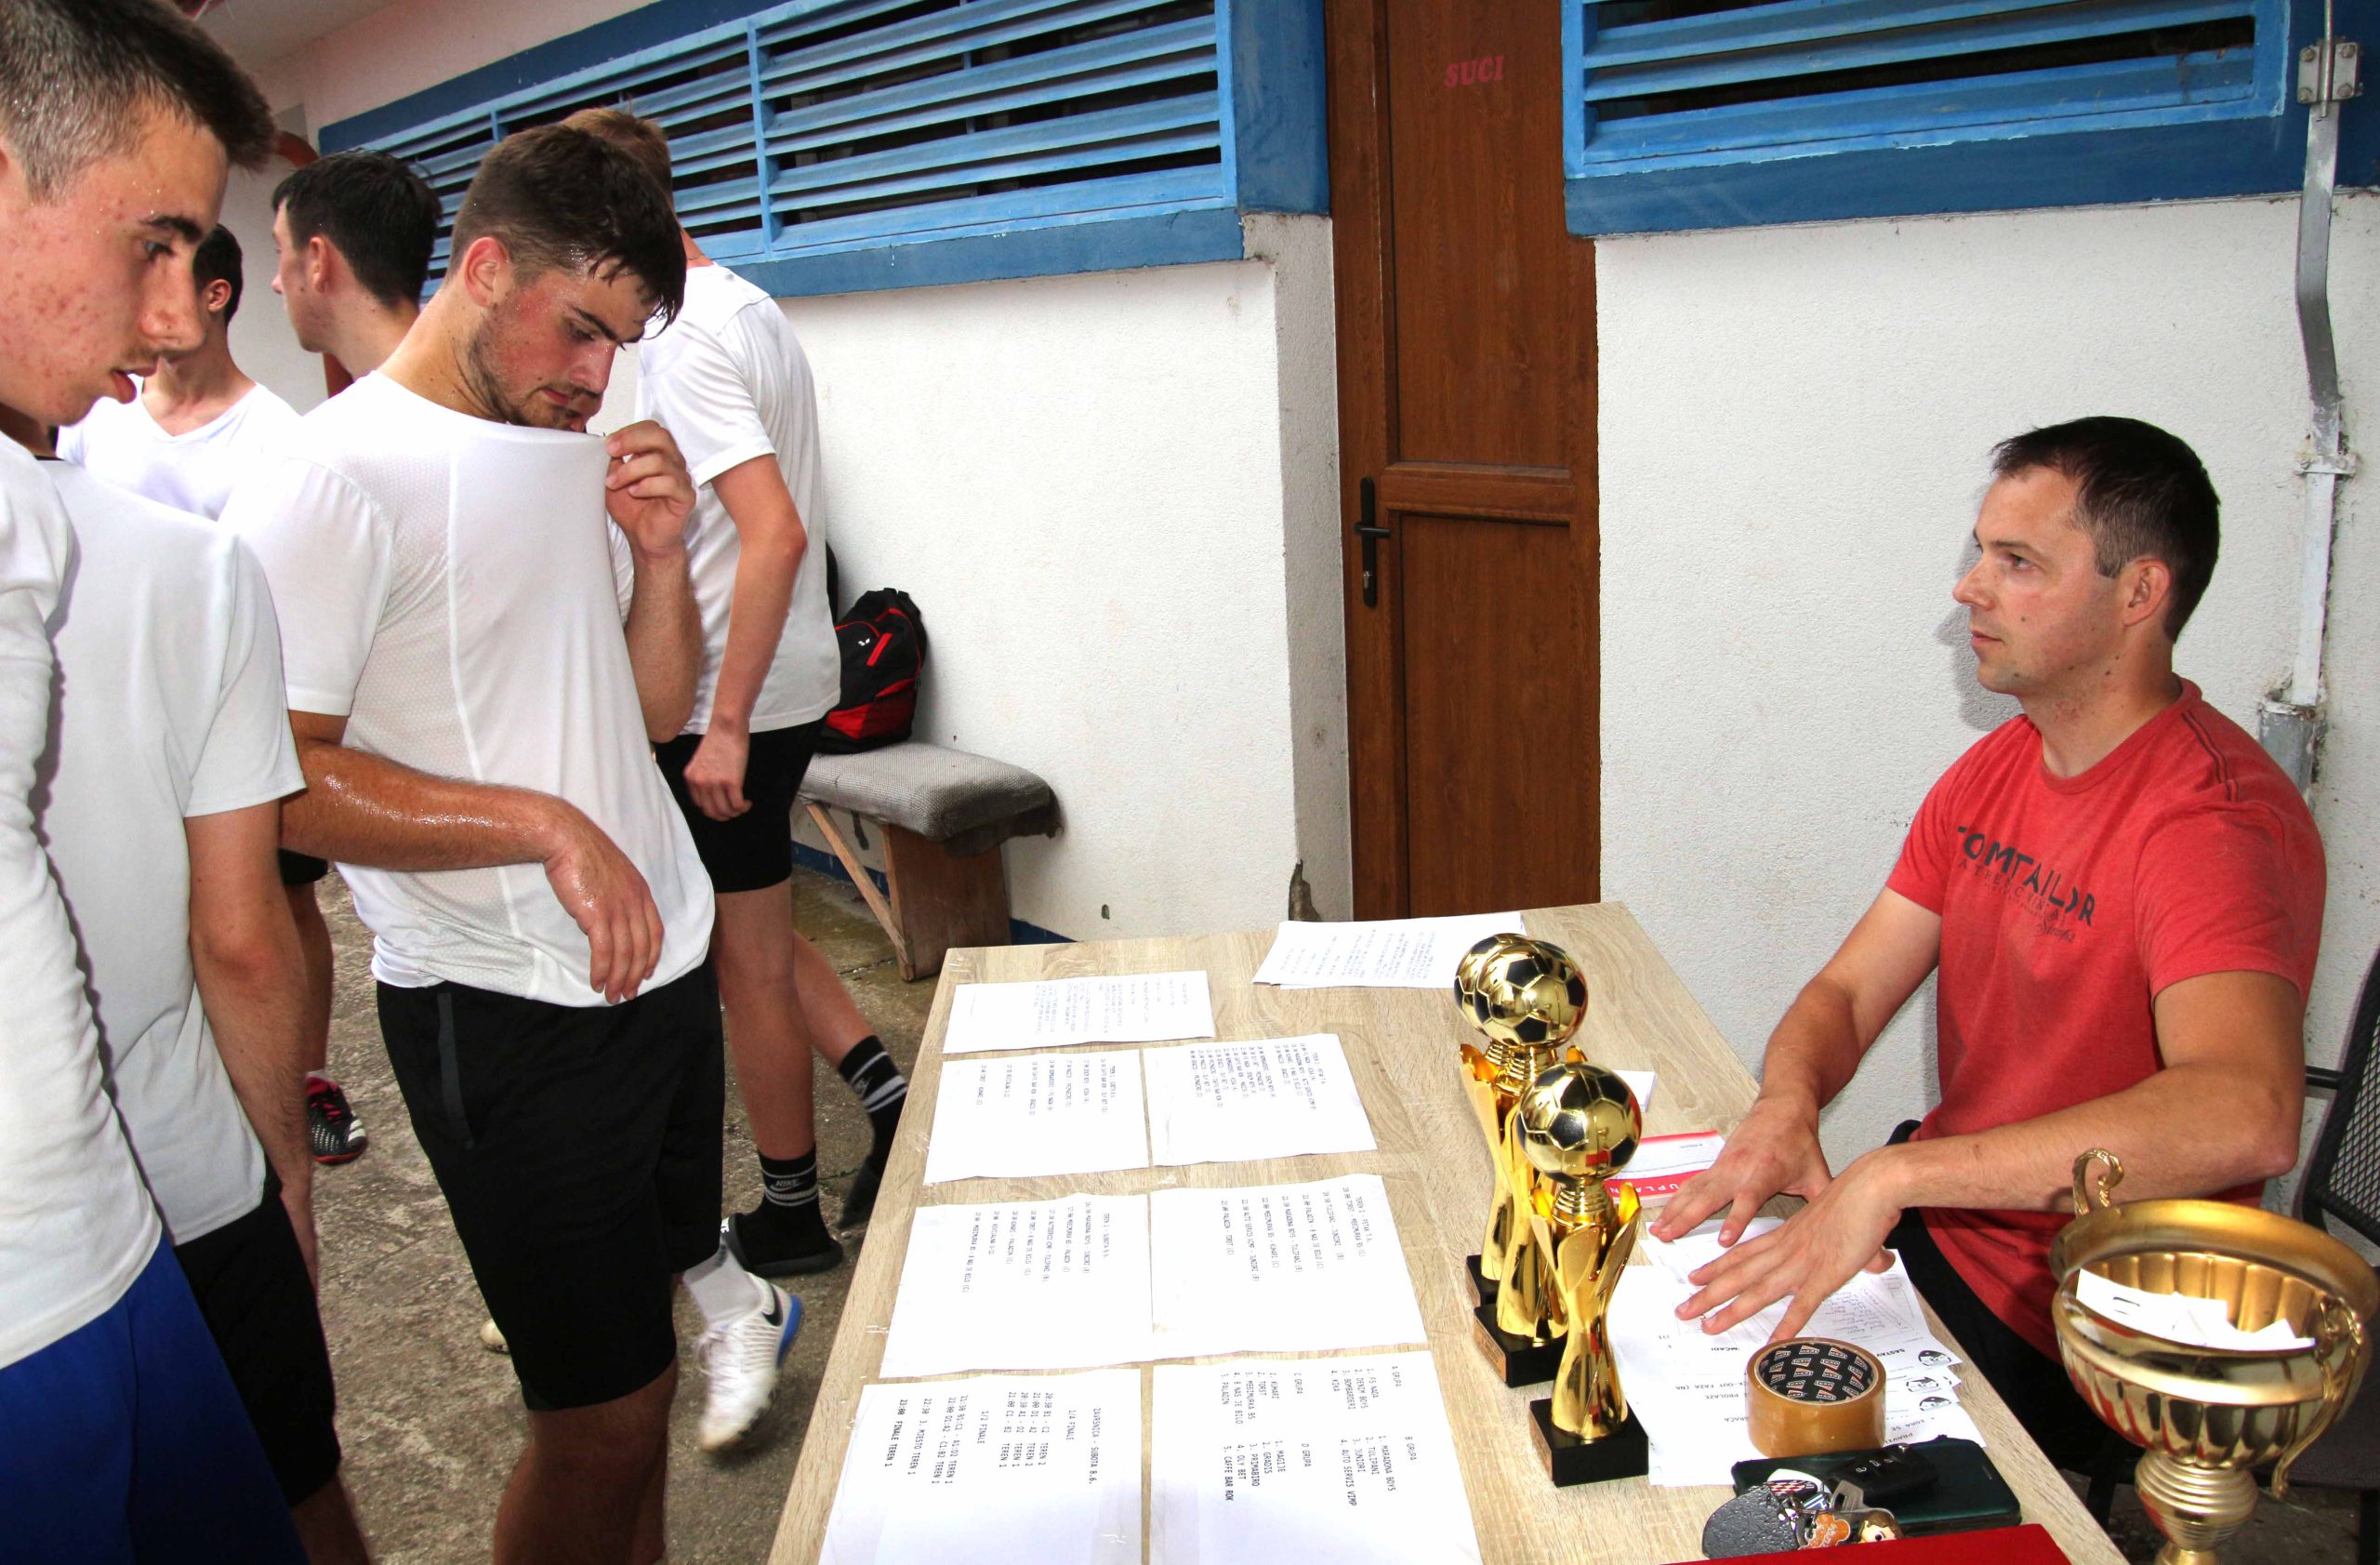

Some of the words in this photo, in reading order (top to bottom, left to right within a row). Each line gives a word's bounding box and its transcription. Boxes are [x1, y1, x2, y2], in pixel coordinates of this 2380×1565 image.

[1258, 1381, 1267, 1396] TORST
[1294, 1379, 1303, 1394] GRUPA
[1355, 1378, 1366, 1394] DENIM
[1392, 1372, 1402, 1387] GRUPA
[1222, 1382, 1230, 1405] PALADIN
[1234, 1387, 1242, 1397] NAS
[1343, 1378, 1355, 1410] BOMBARDERI
[897, 1399, 908, 1415] 23:00
[1359, 1396, 1368, 1409] BOYS
[1235, 1410, 1243, 1424] BILO
[891, 1421, 903, 1440] FINALE
[914, 1429, 925, 1450] MJESTO
[977, 1424, 987, 1444] FINALE
[1066, 1422, 1076, 1440] FINALE
[886, 1443, 898, 1461] TEREN
[1000, 1443, 1010, 1461] TEREN
[1012, 1443, 1023, 1461] TEREN
[1025, 1442, 1036, 1460] TEREN
[1038, 1442, 1049, 1459] TEREN
[1090, 1447, 1099, 1467] SUBOTA
[1302, 1450, 1312, 1467] GRUPA
[1342, 1450, 1351, 1464] AUTO
[1382, 1445, 1393, 1474] MARADONA
[1407, 1443, 1417, 1461] GRUPA
[909, 1452, 920, 1469] TEREN
[946, 1460, 957, 1478] TEREN
[1223, 1456, 1233, 1473] CAFFE
[1236, 1454, 1246, 1466] OLY
[1263, 1452, 1273, 1474] GRADIS
[1276, 1451, 1286, 1473] MAGIJE
[1355, 1449, 1366, 1473] JUNIORI
[1368, 1447, 1380, 1475] TULIPANI
[933, 1461, 945, 1479] TEREN
[1237, 1468, 1247, 1479] BET
[1250, 1453, 1260, 1487] PRIMABIRO
[1343, 1466, 1355, 1488] SERVIS
[1224, 1476, 1234, 1488] BAR
[1385, 1477, 1396, 1492] BOYS
[1224, 1490, 1235, 1502] ROK
[1347, 1491, 1357, 1506] VIMP
